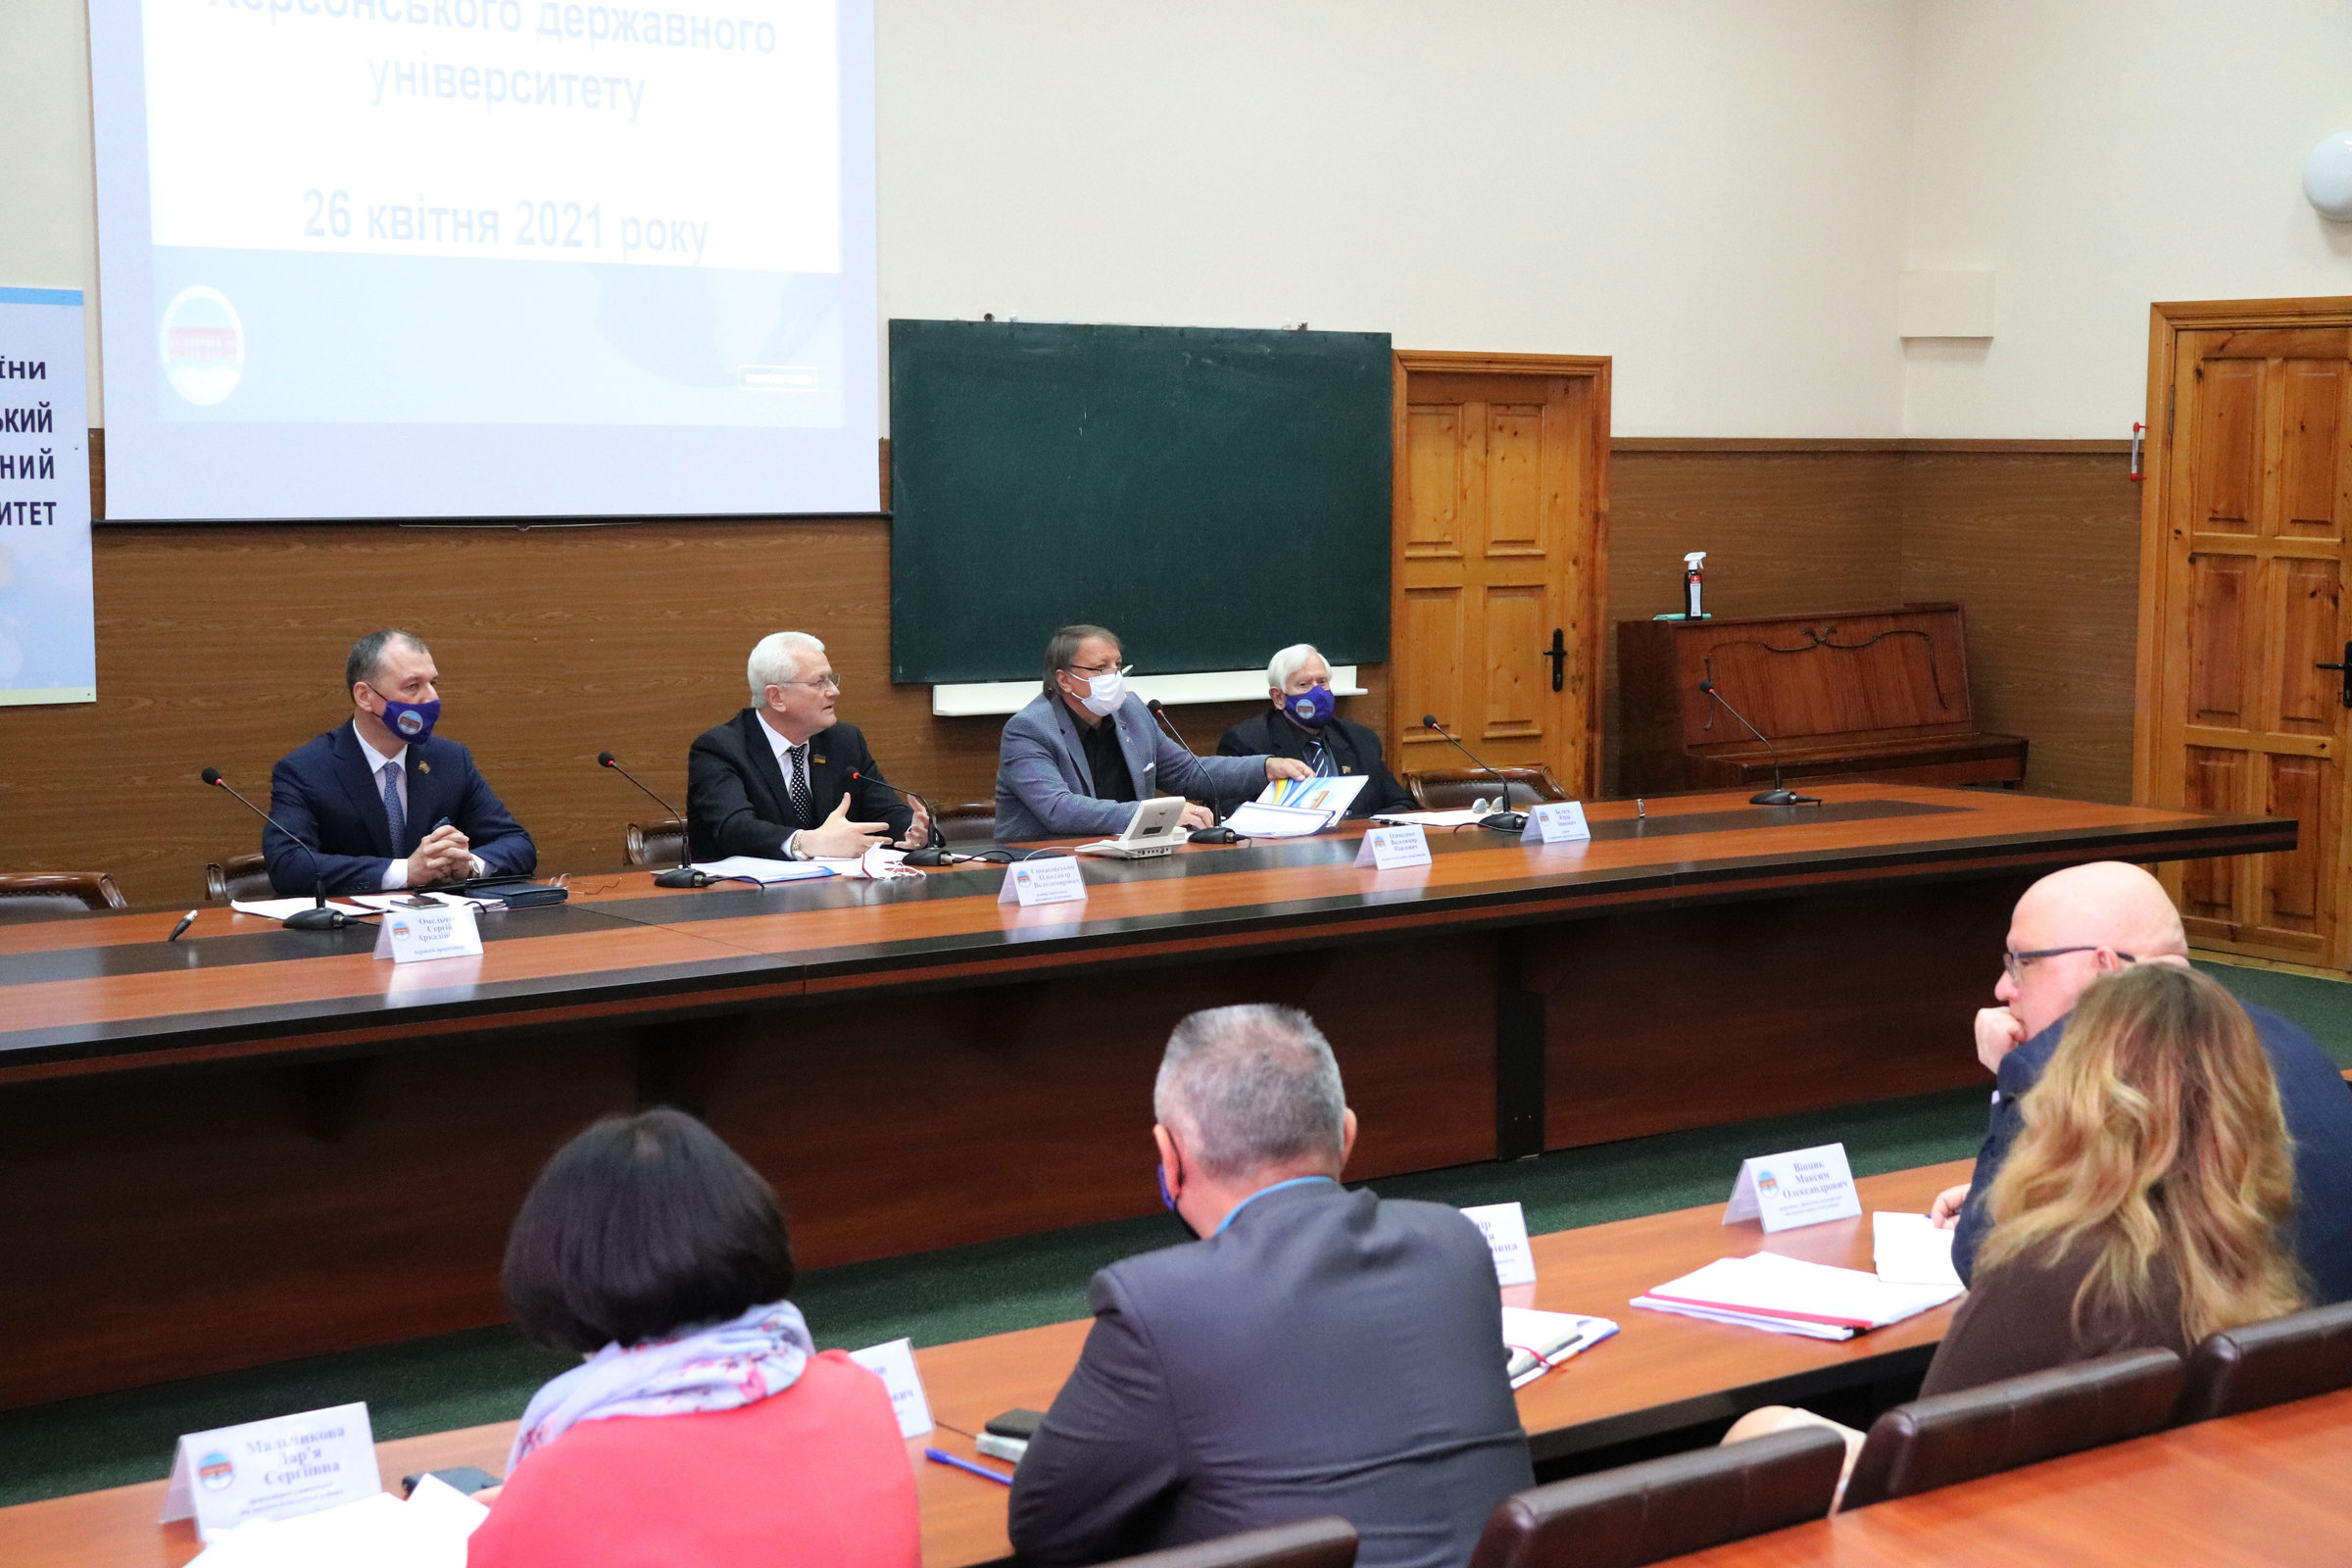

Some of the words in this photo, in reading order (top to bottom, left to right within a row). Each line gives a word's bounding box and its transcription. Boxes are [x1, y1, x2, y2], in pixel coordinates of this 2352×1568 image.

[209, 0, 521, 32] рсонського
[536, 2, 776, 54] державного
[368, 49, 646, 124] університету
[303, 188, 352, 238] 26
[368, 193, 500, 244] квітня
[514, 199, 602, 249] 2021
[621, 215, 709, 266] року
[0, 447, 55, 479] НИЙ
[1783, 1181, 1848, 1199] Олександрович
[1795, 1172, 1831, 1184] Максим
[246, 1427, 346, 1454] Мальчикова
[264, 1462, 341, 1487] Сергіївна
